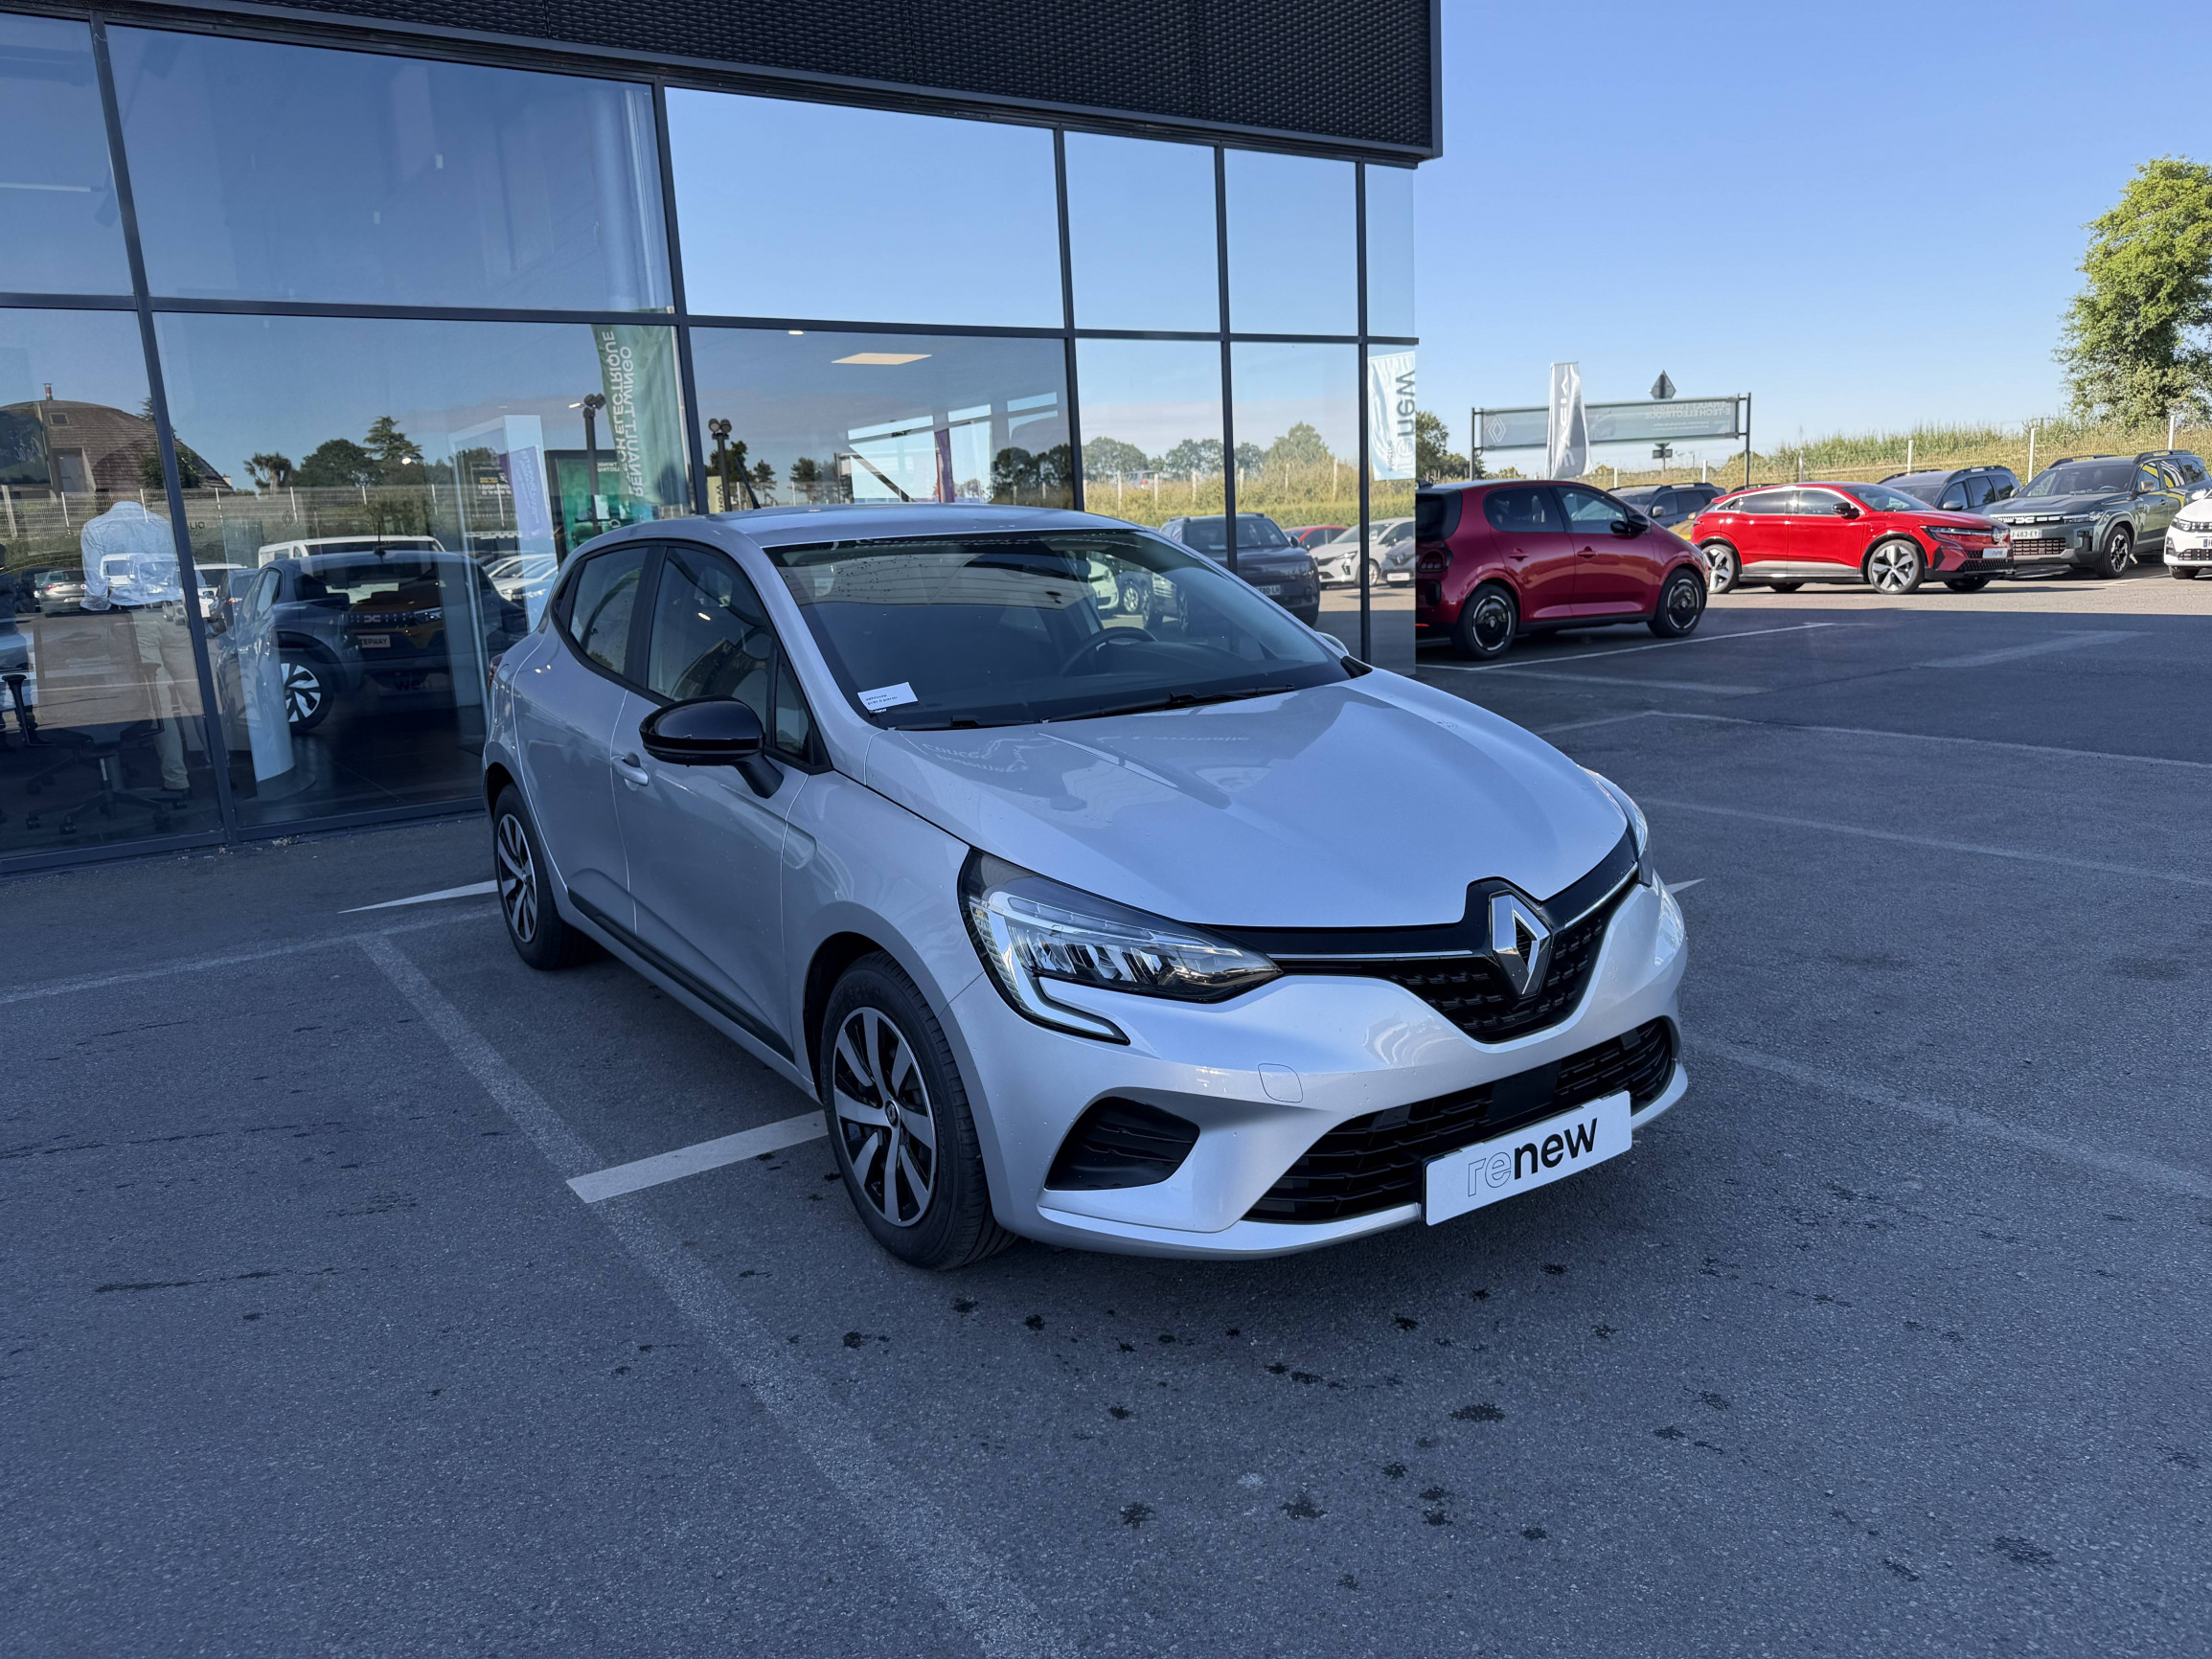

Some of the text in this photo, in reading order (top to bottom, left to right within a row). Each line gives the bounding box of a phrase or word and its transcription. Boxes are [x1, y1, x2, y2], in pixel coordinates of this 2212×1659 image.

[190, 521, 205, 530] LIO
[360, 637, 388, 646] EPWAY
[1468, 1117, 1598, 1197] renew
